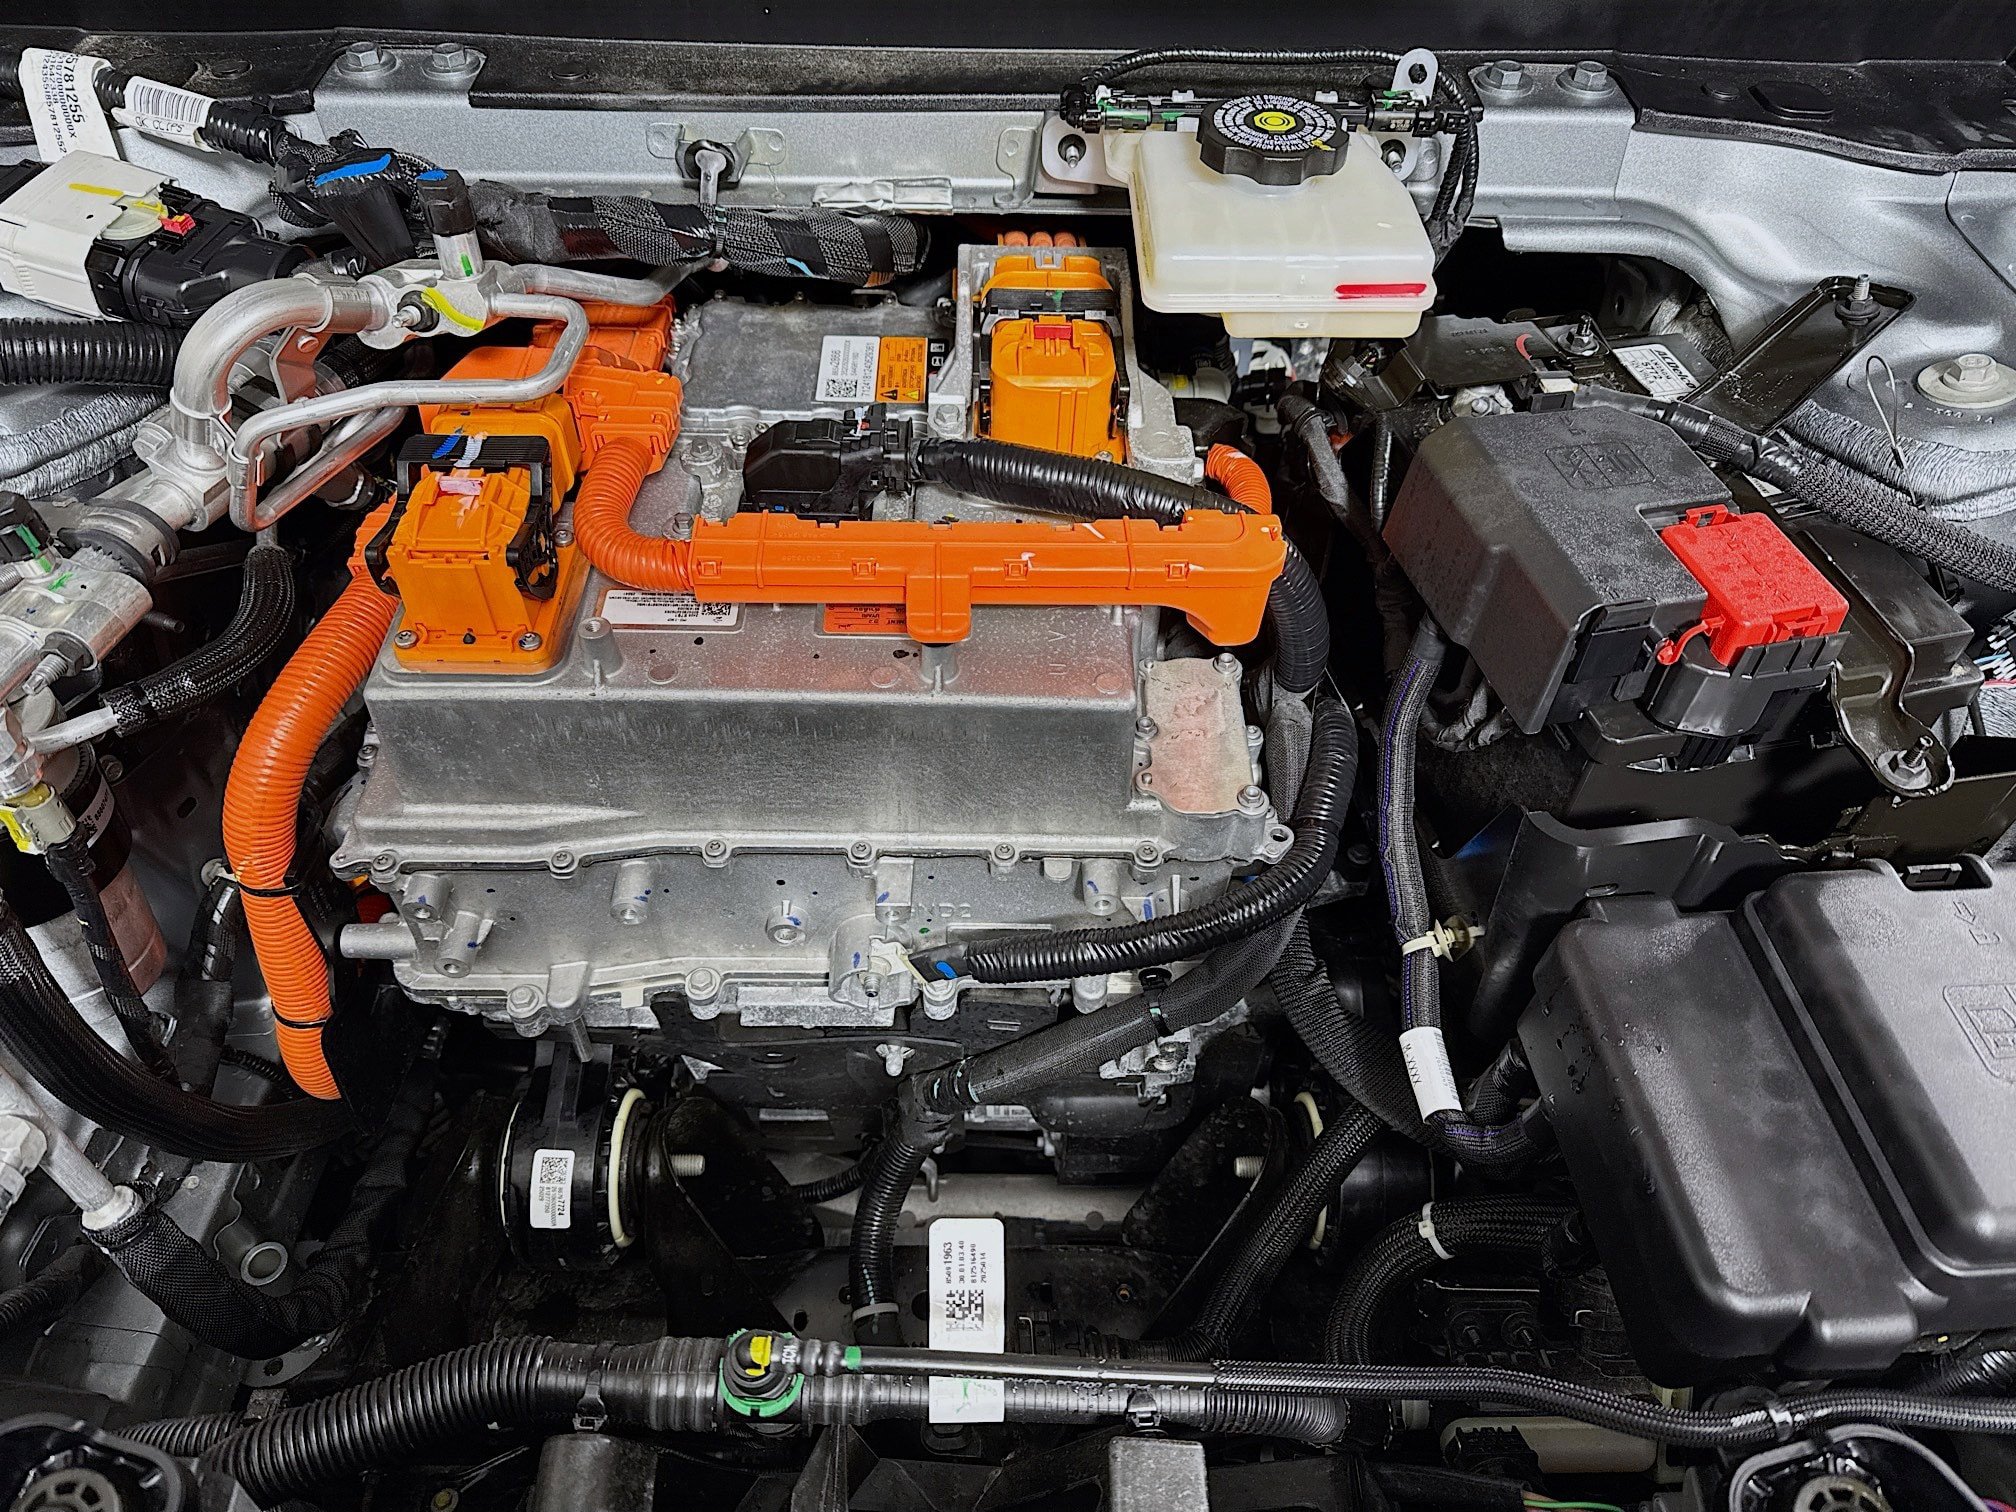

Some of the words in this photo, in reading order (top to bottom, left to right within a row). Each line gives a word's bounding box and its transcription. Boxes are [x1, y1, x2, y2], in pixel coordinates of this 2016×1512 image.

[64, 54, 85, 123] 5781255
[1263, 94, 1298, 103] BOUCHON
[1274, 133, 1298, 141] CLEAN
[1251, 142, 1274, 150] FROM
[1655, 350, 1697, 389] ACDelco
